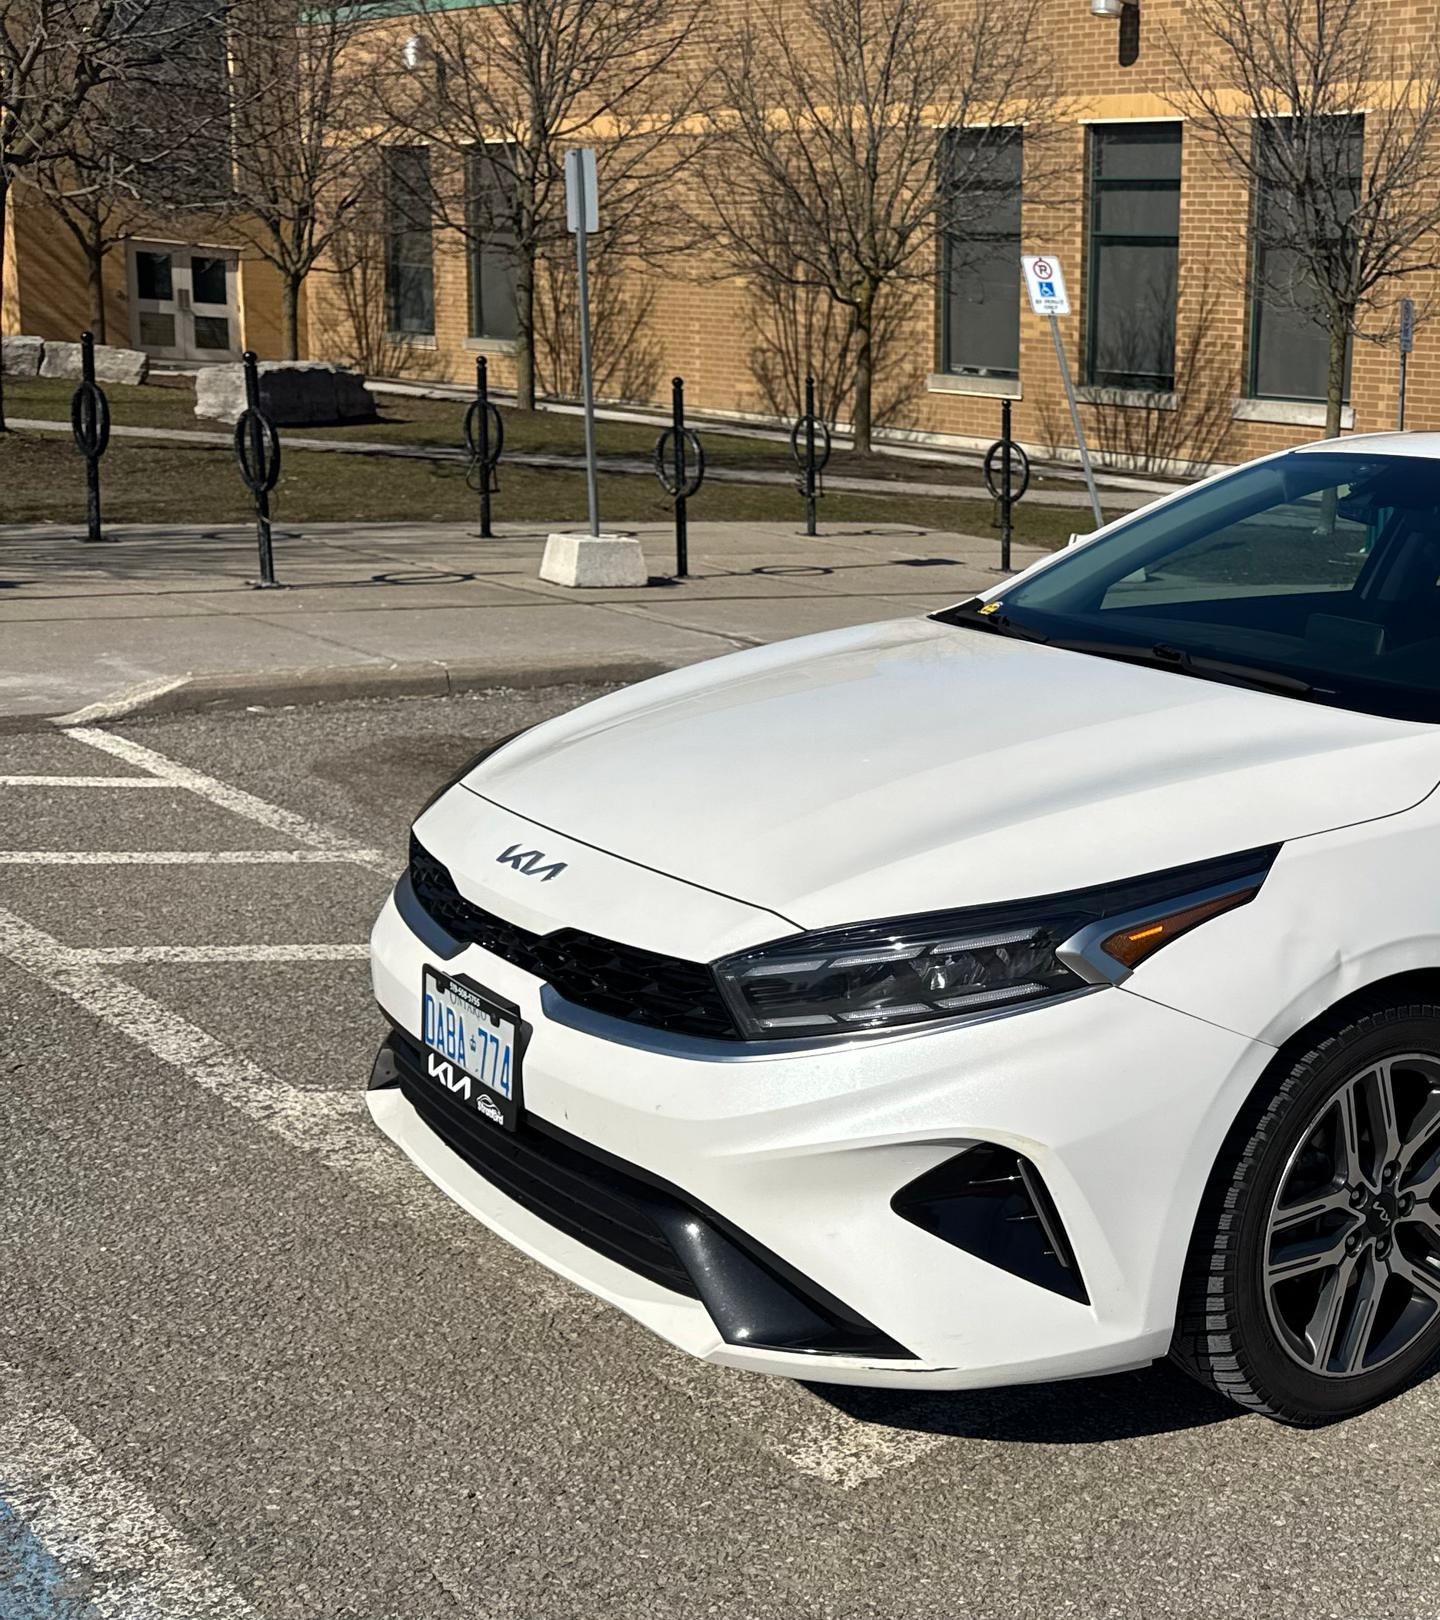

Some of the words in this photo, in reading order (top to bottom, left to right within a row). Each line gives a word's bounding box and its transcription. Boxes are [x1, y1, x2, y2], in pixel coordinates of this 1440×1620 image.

[496, 843, 568, 882] KIA
[425, 993, 466, 1068] DABA
[478, 1028, 511, 1097] 774
[428, 1052, 471, 1101] KIA
